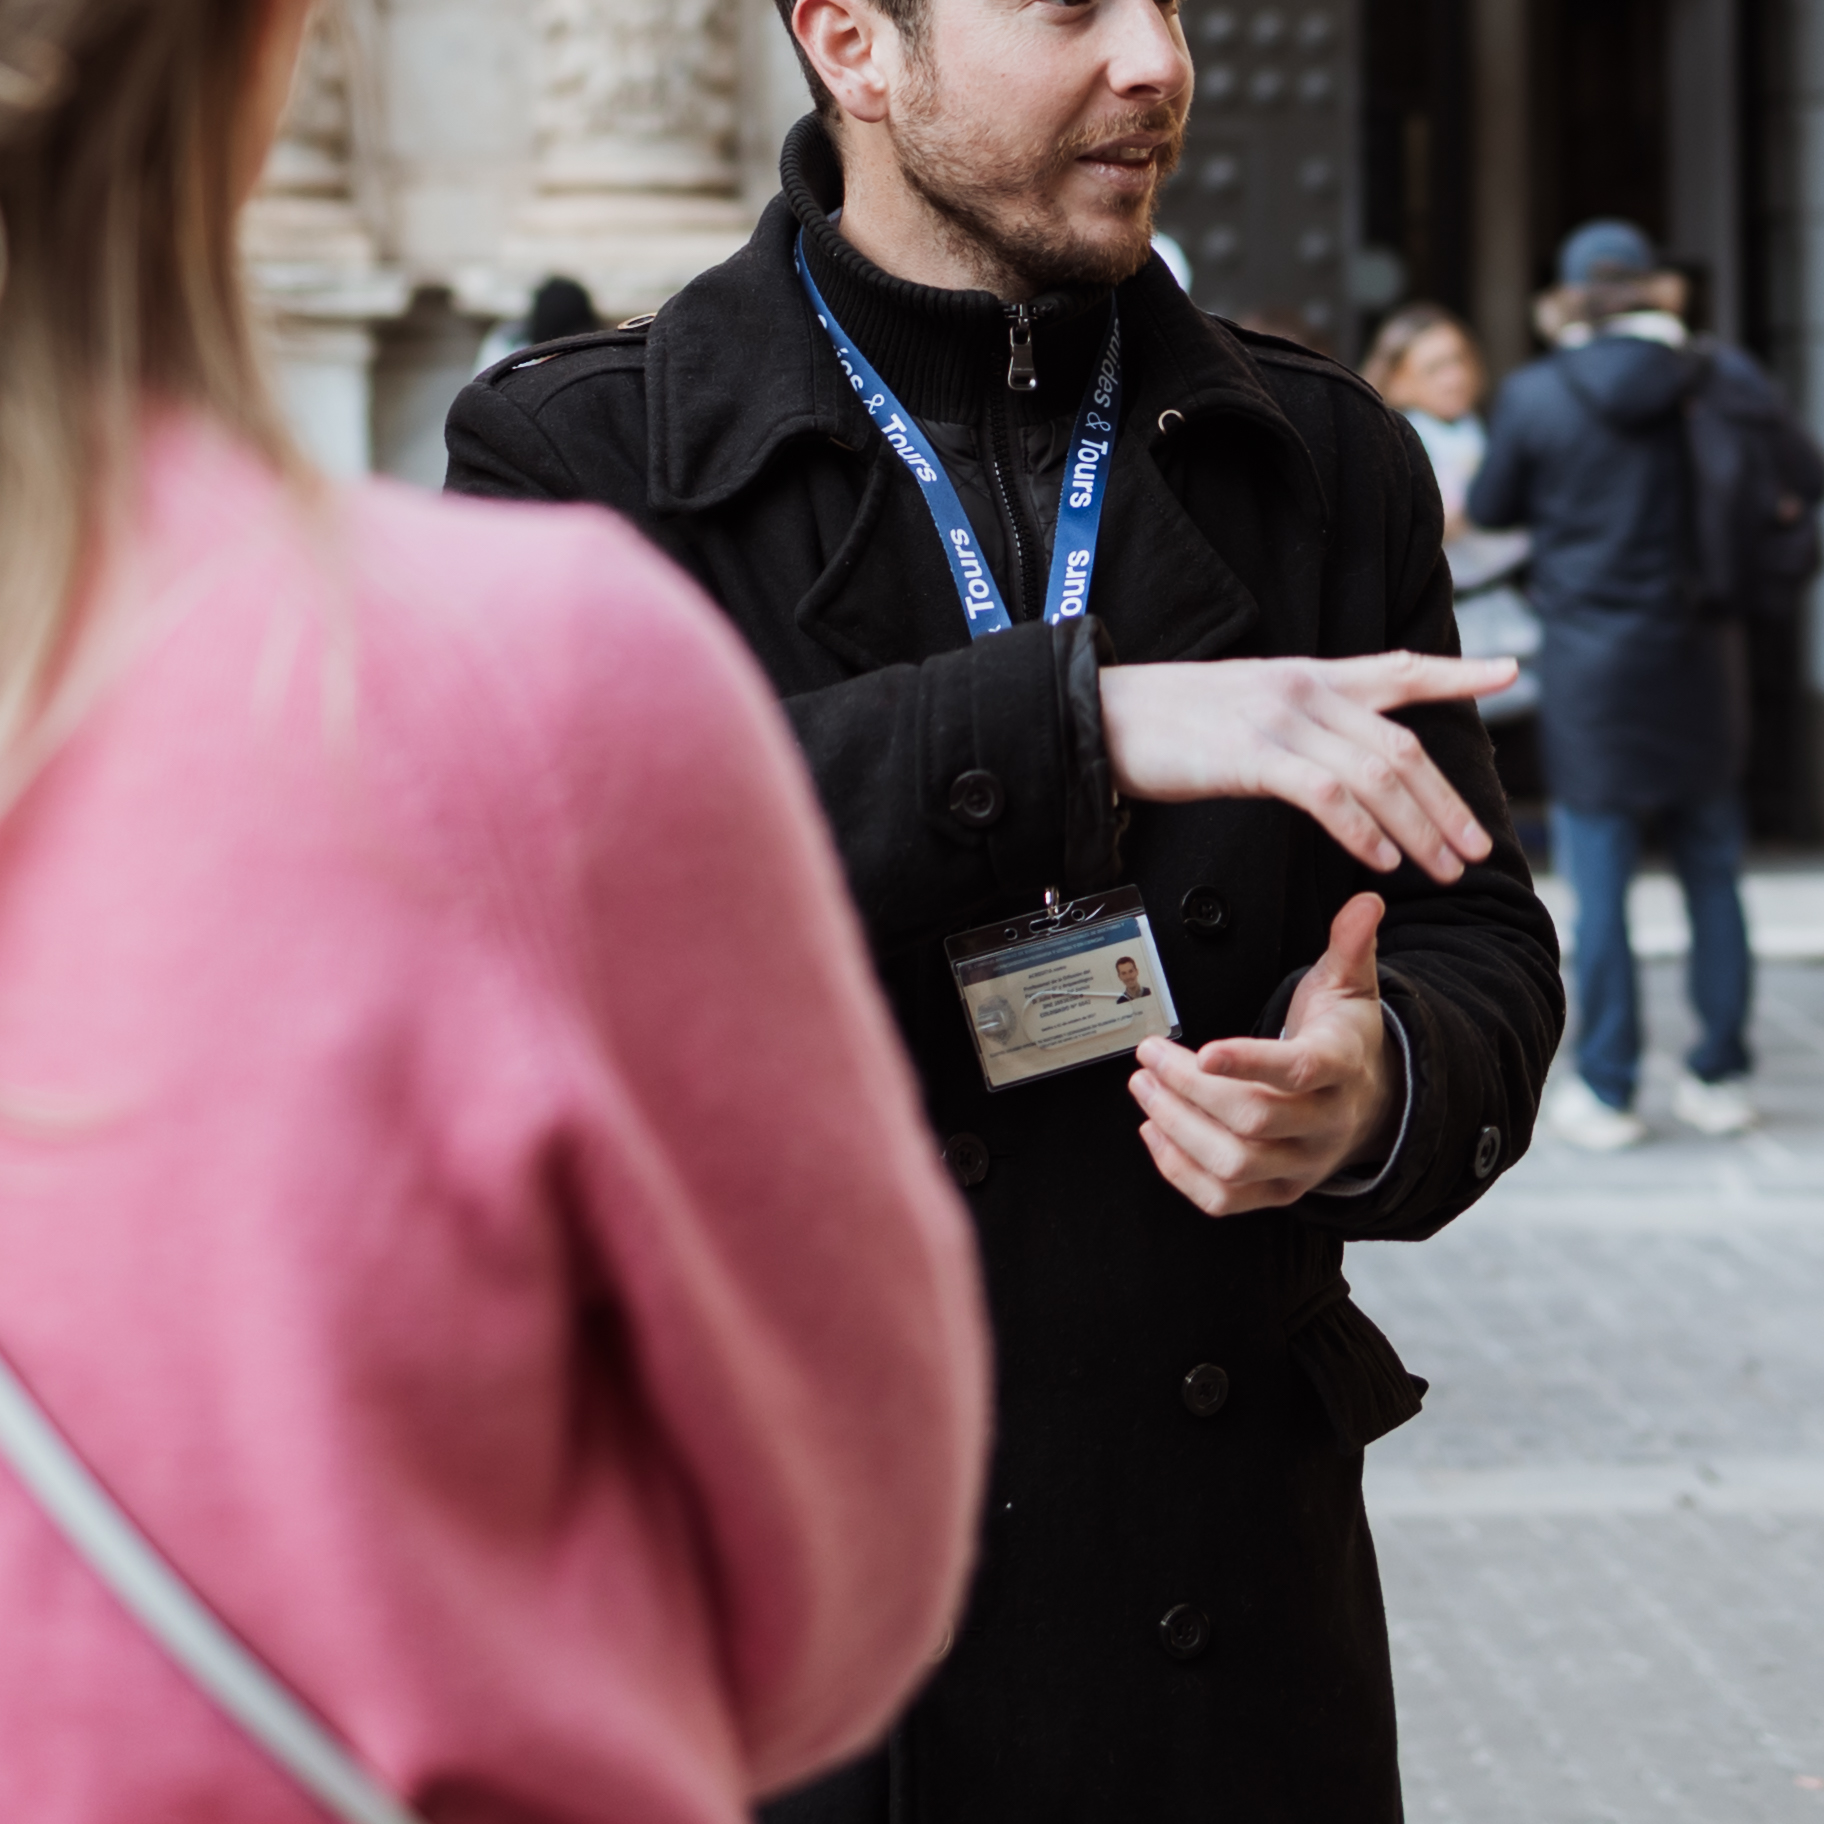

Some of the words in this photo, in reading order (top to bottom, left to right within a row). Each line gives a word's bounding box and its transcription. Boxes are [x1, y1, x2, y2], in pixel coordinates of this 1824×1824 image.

[881, 413, 938, 482] Tours
[1085, 411, 1111, 432] &
[1069, 438, 1108, 508] Tours
[950, 528, 994, 620] Tours
[1052, 549, 1090, 626] ours
